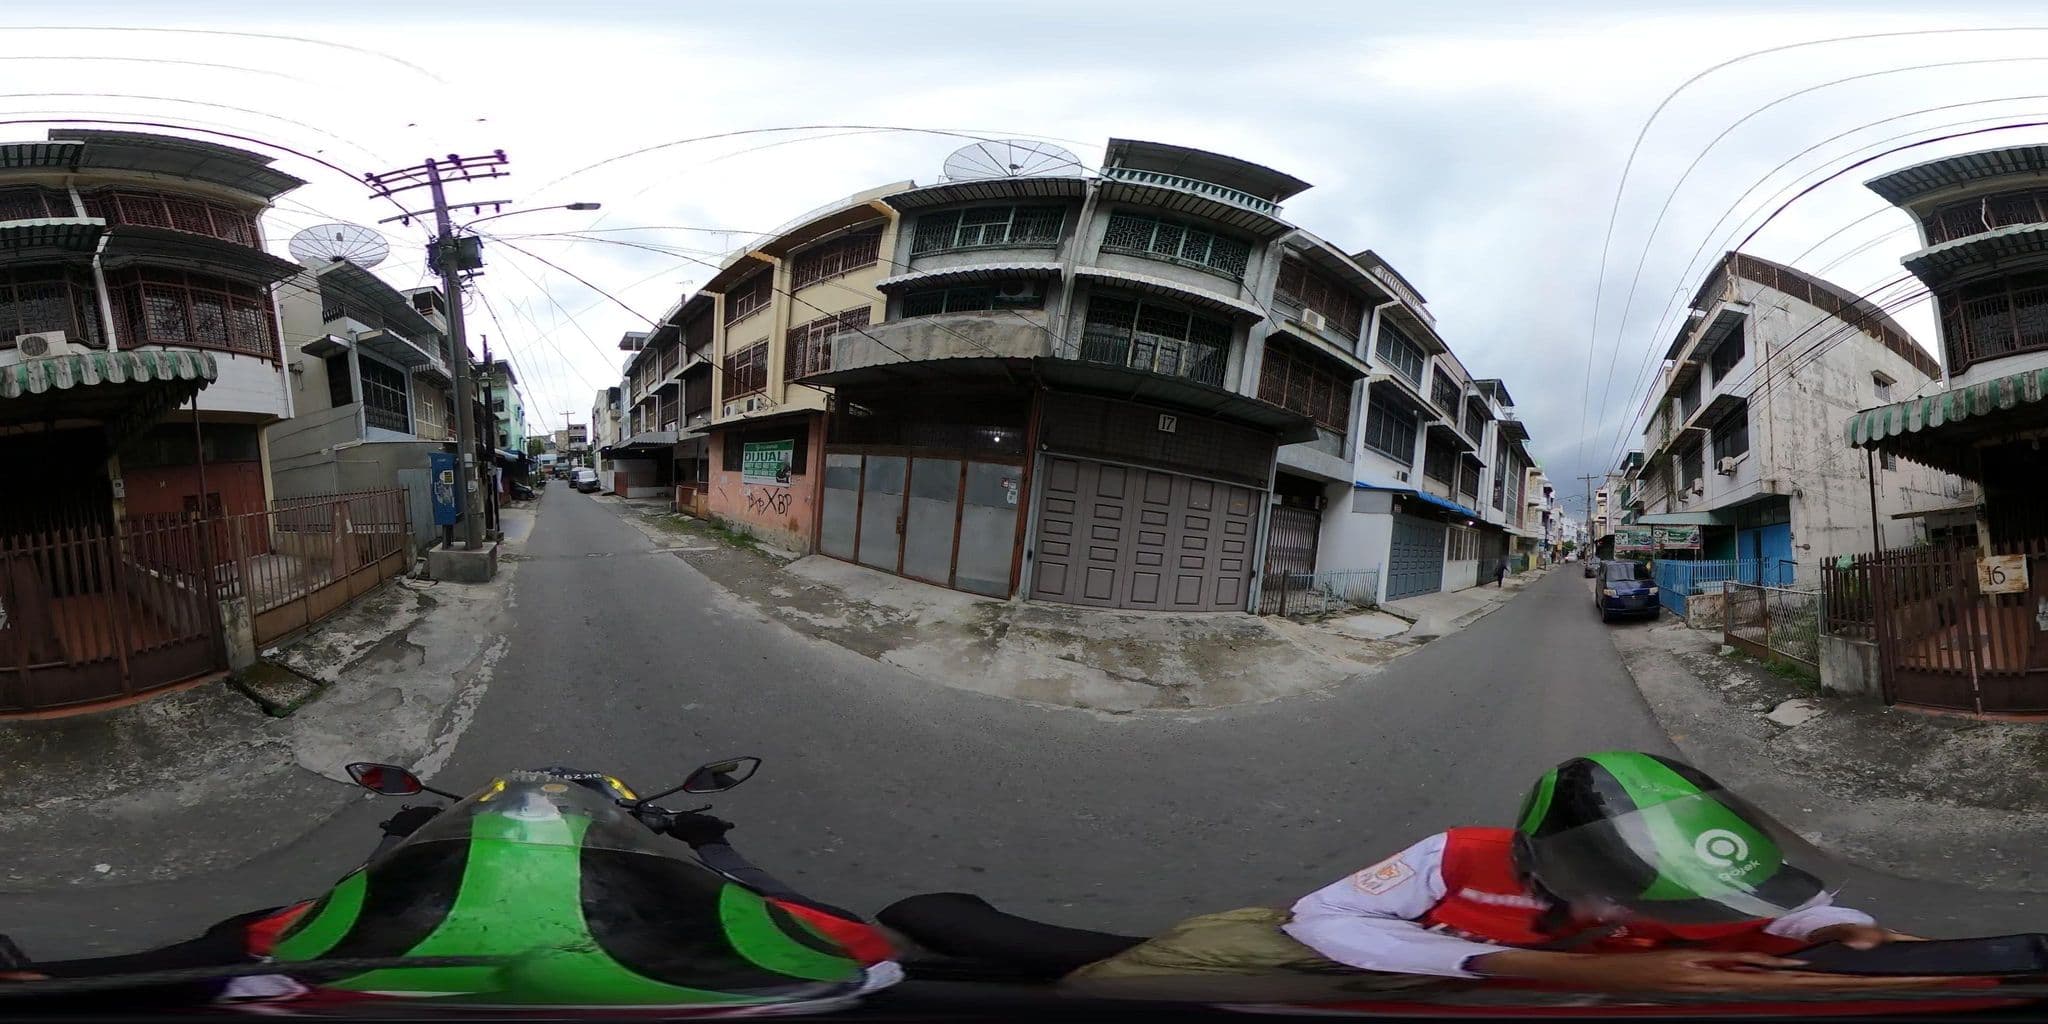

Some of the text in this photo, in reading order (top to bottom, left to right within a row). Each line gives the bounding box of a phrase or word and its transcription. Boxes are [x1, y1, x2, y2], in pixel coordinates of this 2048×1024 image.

[1161, 416, 1175, 430] 17
[744, 451, 783, 462] DIJUAL
[1984, 565, 2006, 586] 16
